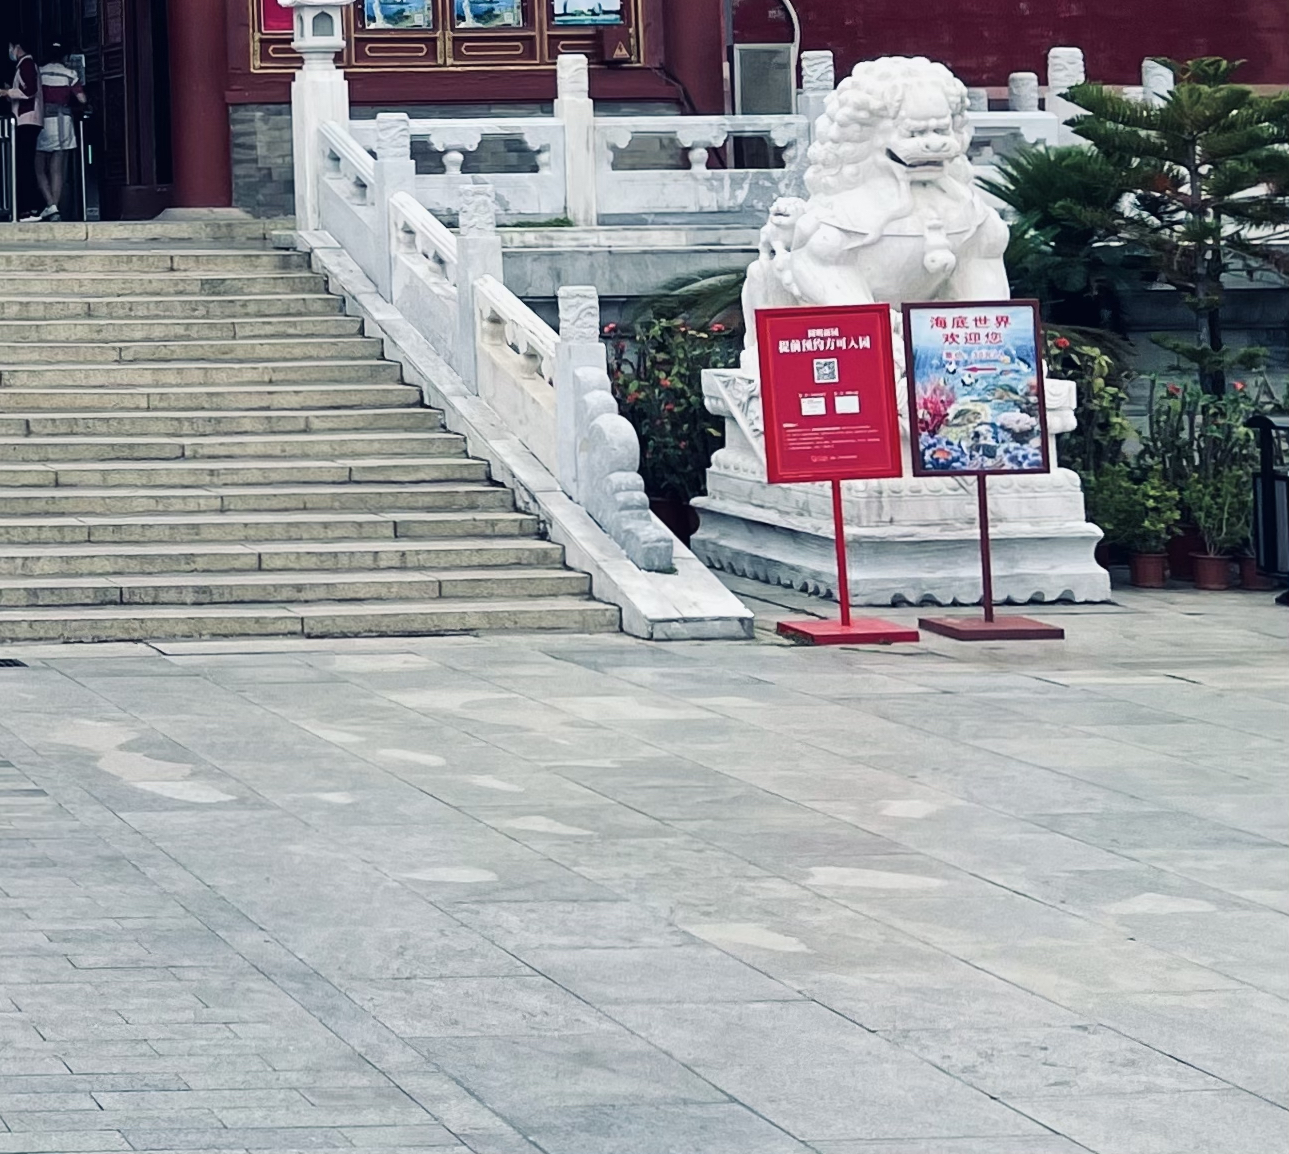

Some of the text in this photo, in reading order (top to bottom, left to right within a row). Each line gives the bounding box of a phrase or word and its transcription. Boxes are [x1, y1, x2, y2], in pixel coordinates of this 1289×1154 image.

[930, 315, 1011, 329] 海底世界
[778, 335, 871, 353] 提前预约方可入园
[942, 332, 1003, 345] 欢迎您
